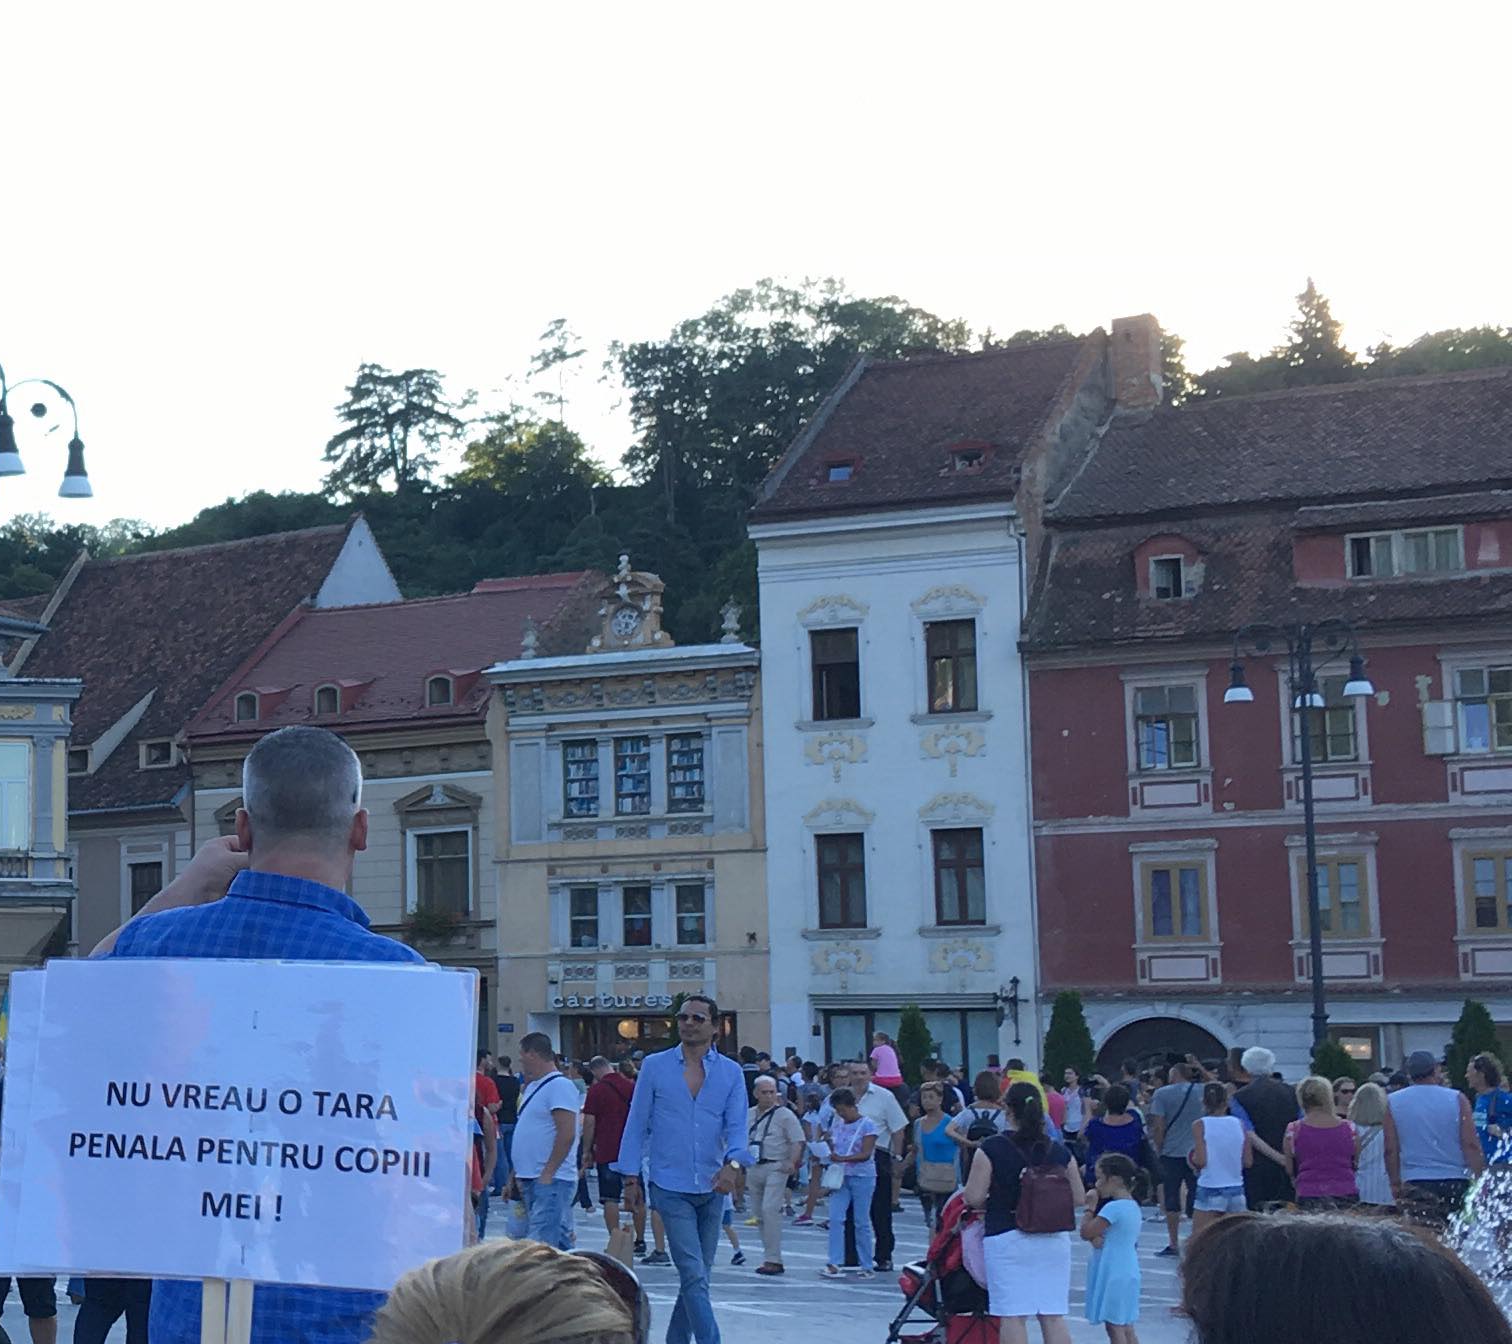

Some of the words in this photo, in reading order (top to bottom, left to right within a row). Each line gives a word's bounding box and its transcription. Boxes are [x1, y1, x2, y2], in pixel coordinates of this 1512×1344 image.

[106, 1081, 151, 1107] NU
[161, 1083, 267, 1113] VREAU
[278, 1088, 302, 1115] O
[313, 1090, 398, 1121] TARA
[69, 1132, 186, 1163] PENALA
[196, 1138, 324, 1171] PENTRU
[334, 1146, 431, 1178] COPIII
[201, 1191, 261, 1220] MEI
